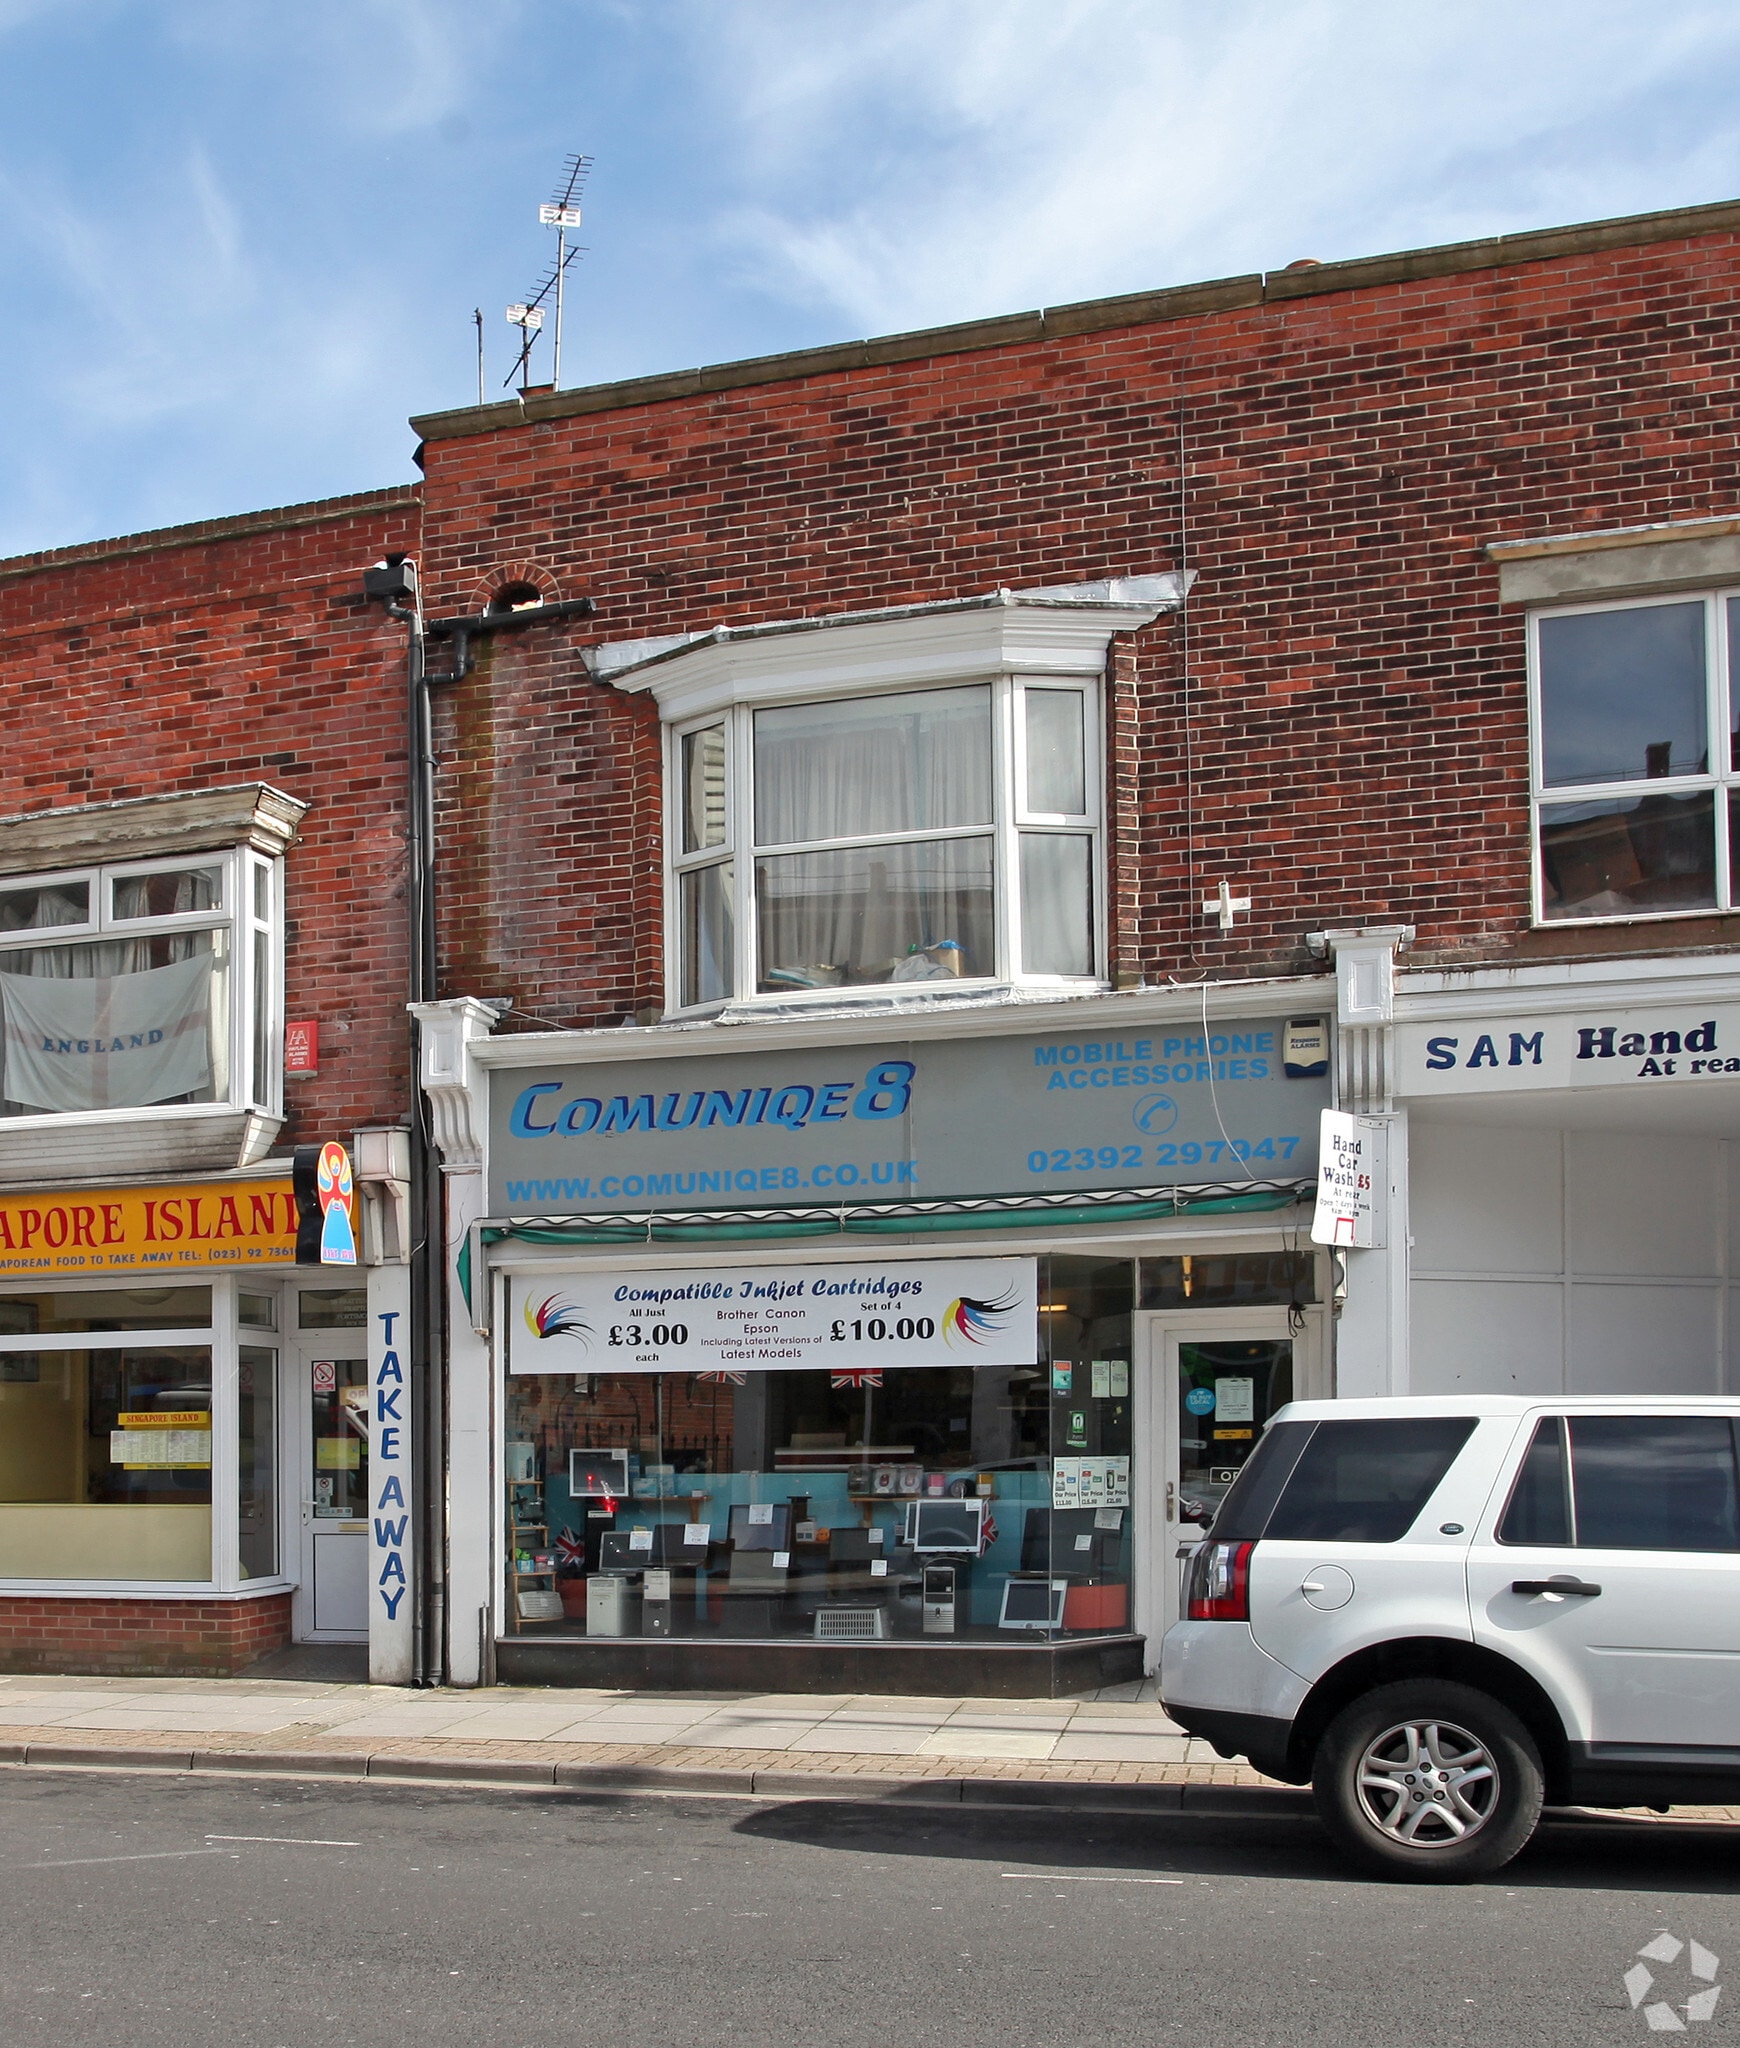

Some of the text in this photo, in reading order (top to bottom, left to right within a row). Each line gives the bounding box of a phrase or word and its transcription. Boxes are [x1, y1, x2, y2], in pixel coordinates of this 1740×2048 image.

[42, 1029, 164, 1054] ENGLAND
[1034, 1032, 1274, 1066] MOBILE PHONE
[1425, 1020, 1718, 1070] SAM Hand
[1046, 1058, 1269, 1091] ACCESSORIES
[1637, 1057, 1740, 1077] At rea
[1027, 1136, 1300, 1173] 02392 297947
[1333, 1135, 1362, 1155] Hand
[1338, 1154, 1358, 1171] Car
[507, 1160, 919, 1202] WWW.COMUNIQE8.CO.UK
[1323, 1167, 1370, 1190] Wash £5
[1333, 1187, 1360, 1200] At rear
[56, 1255, 86, 1266] FOOD
[91, 1255, 104, 1264] TO
[109, 1254, 136, 1264] TAKE
[141, 1252, 174, 1263] AWAY
[178, 1250, 202, 1261] TEL:
[208, 1247, 242, 1261] (023)
[247, 1248, 262, 1257] 92
[614, 1276, 922, 1304] Compatible Inkjet Cartridges
[629, 1308, 666, 1317] All Just
[717, 1308, 806, 1320] Brother Canon
[860, 1301, 902, 1311] Set of 4
[607, 1323, 689, 1346] £3.00
[744, 1324, 779, 1335] Epson
[830, 1317, 935, 1341] £10.00
[700, 1335, 822, 1347] Including Latest Versions of
[635, 1353, 659, 1362] each
[721, 1348, 802, 1360] Latest Models
[376, 1311, 403, 1461] TAKE
[126, 1413, 199, 1423] SINGAPORE ISLAND
[374, 1475, 409, 1621] AWAY
